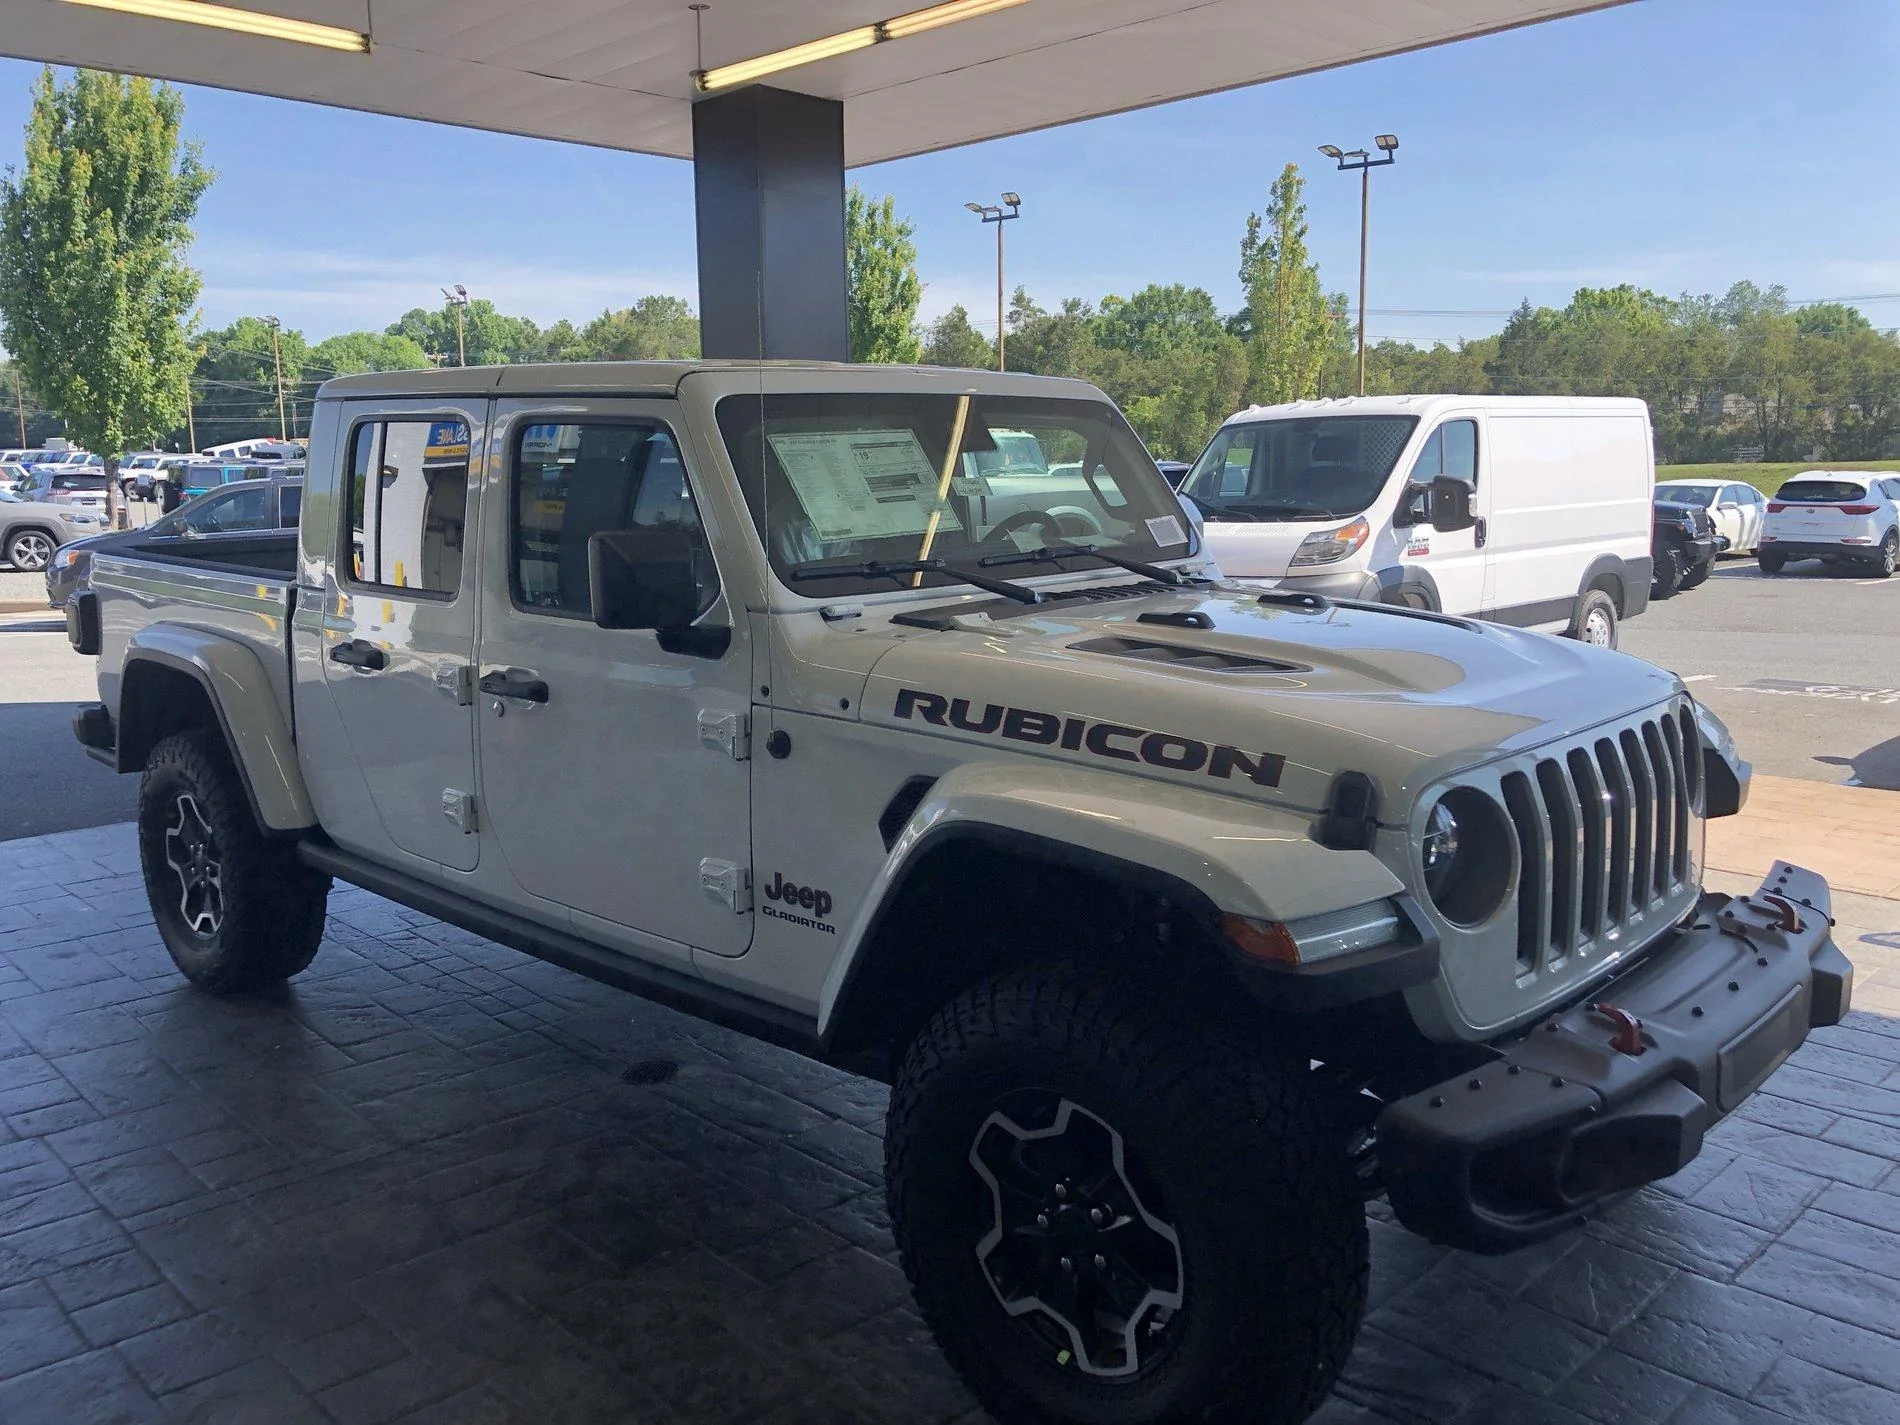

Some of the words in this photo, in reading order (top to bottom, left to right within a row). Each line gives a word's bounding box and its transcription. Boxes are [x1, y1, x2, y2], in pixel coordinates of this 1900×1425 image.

[893, 688, 1286, 788] RUBICON
[764, 871, 832, 918] Jeep
[762, 905, 836, 935] GLADIATOR
